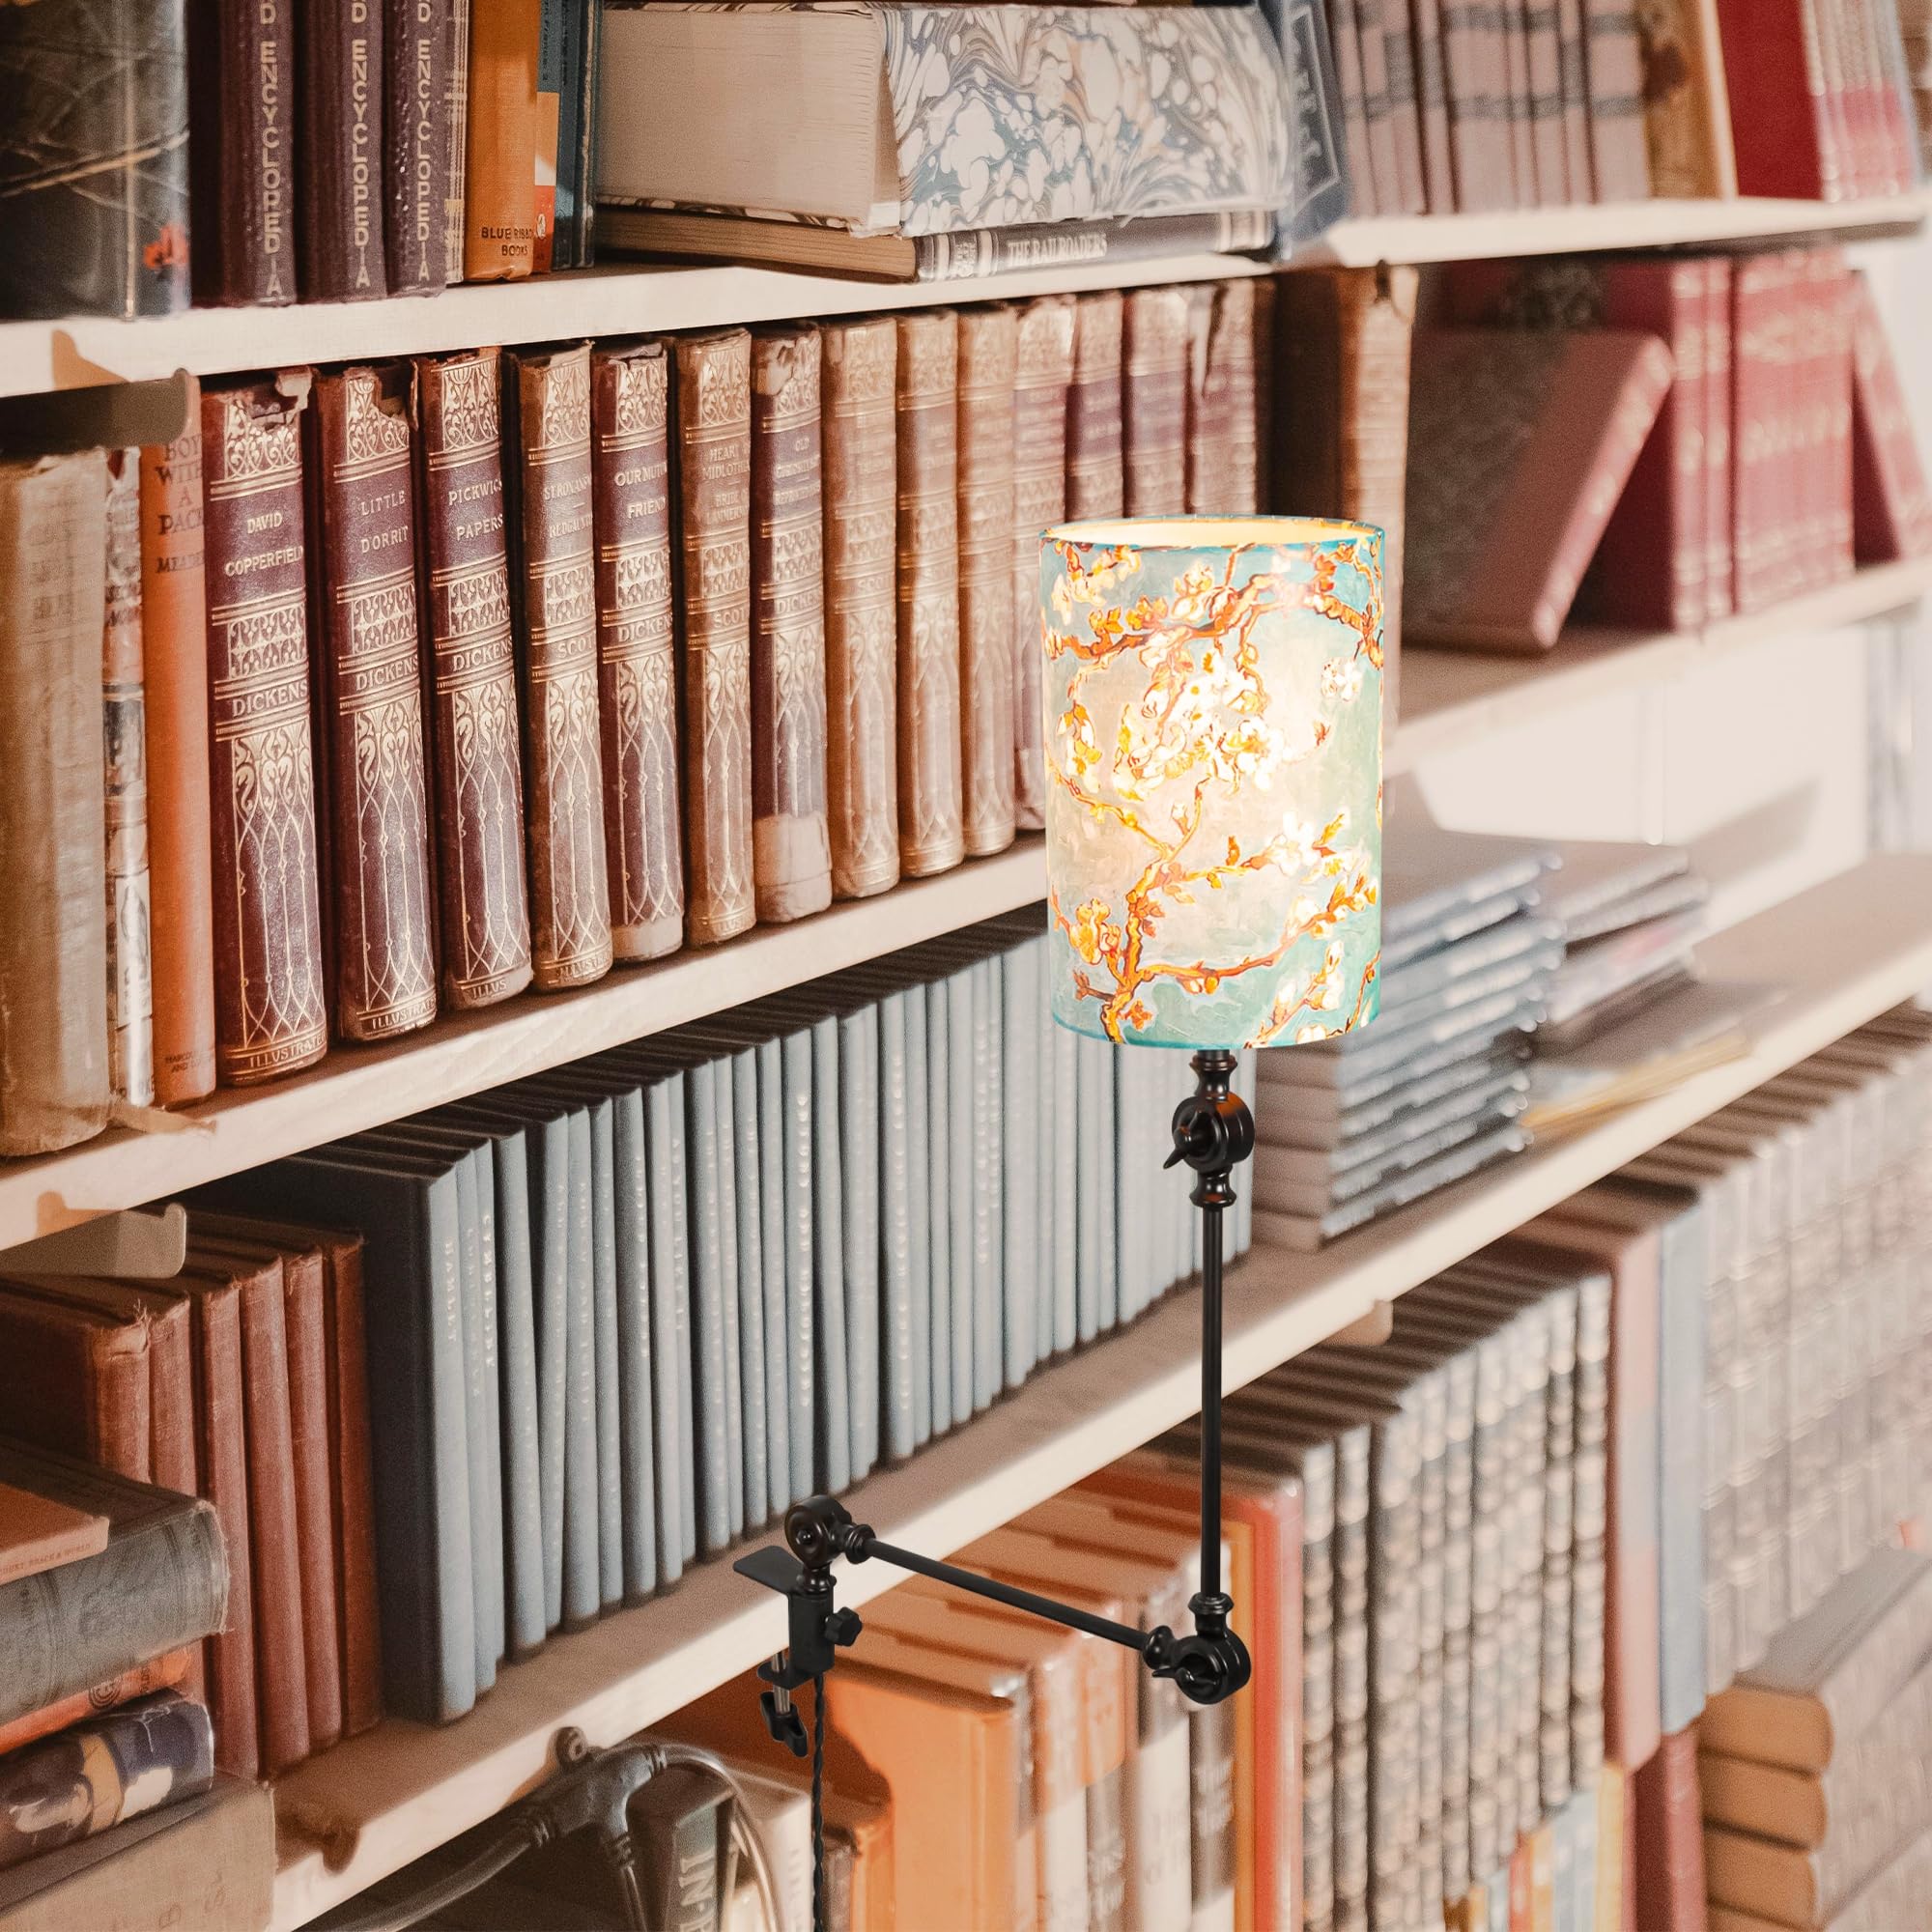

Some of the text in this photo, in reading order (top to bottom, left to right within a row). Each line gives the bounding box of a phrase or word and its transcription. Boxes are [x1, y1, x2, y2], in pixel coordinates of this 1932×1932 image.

[260, 41, 283, 296] ENCYCLOPEDIA
[351, 39, 371, 289] ENCYCLOPEDIA
[416, 39, 432, 281] ENCYCLOPEDIA
[481, 226, 512, 240] BLUE
[1008, 240, 1031, 268] THE
[360, 490, 406, 516] LITTLE
[246, 511, 283, 534] DAVID
[456, 513, 503, 541] PAPERS
[360, 525, 409, 554] DORRIT
[224, 544, 304, 577] COPPERFIELD
[618, 612, 673, 642] DICKEN
[452, 636, 513, 671] DICKENS
[355, 654, 418, 691] DICKENS
[231, 678, 308, 717] DICKENS
[444, 1236, 457, 1342] HAMLET
